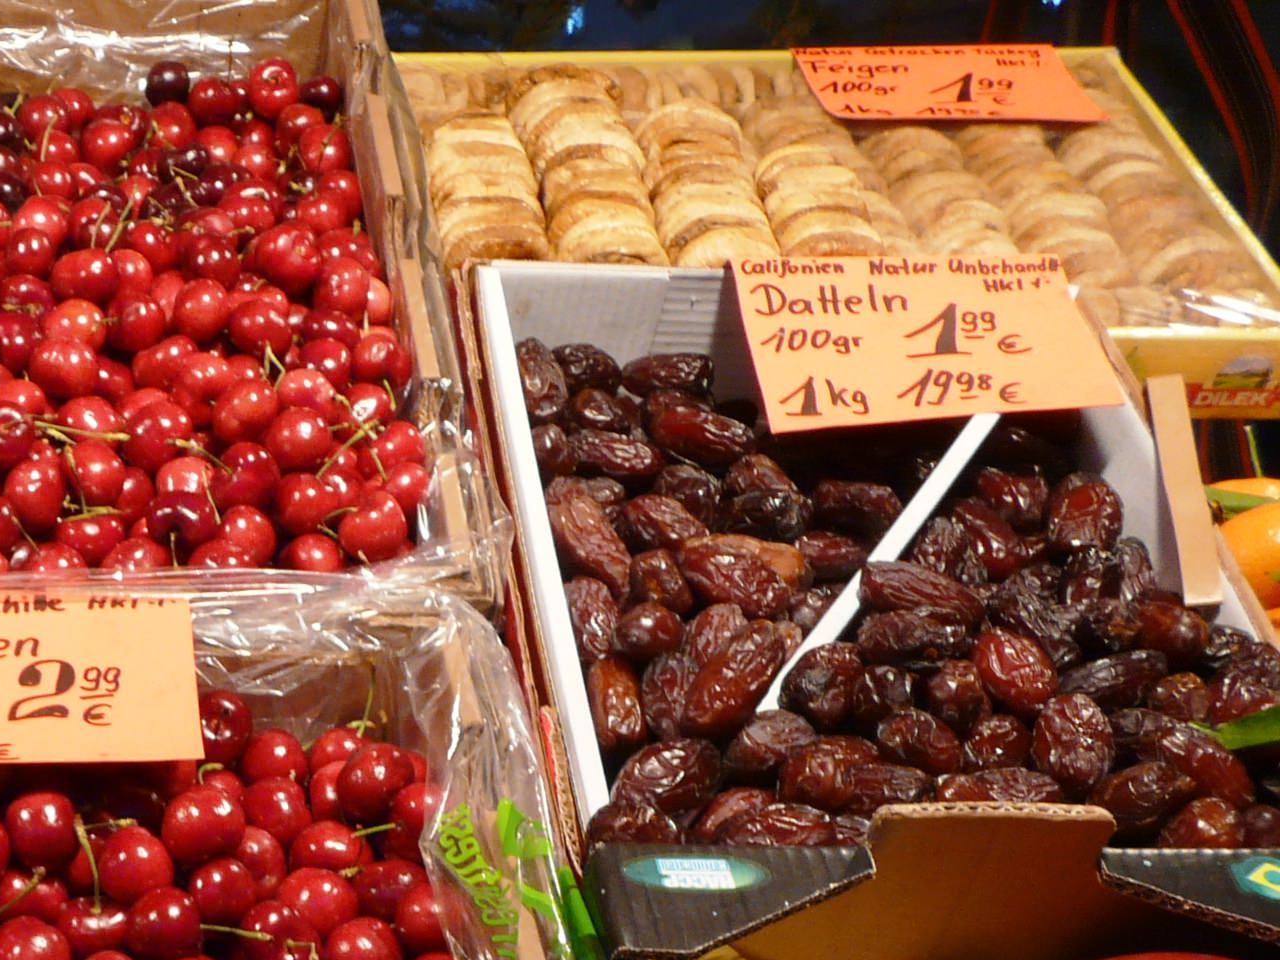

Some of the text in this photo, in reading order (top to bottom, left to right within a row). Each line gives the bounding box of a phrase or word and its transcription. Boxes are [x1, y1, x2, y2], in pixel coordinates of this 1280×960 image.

[804, 59, 910, 79] Feigen
[820, 80, 899, 96] 100gr
[868, 259, 938, 276] Natur
[750, 283, 909, 317] Datteln
[760, 326, 864, 355] 100gr
[996, 333, 1033, 355] €
[998, 381, 1028, 405] €
[1193, 390, 1269, 406] DILEK
[81, 702, 114, 727] €
